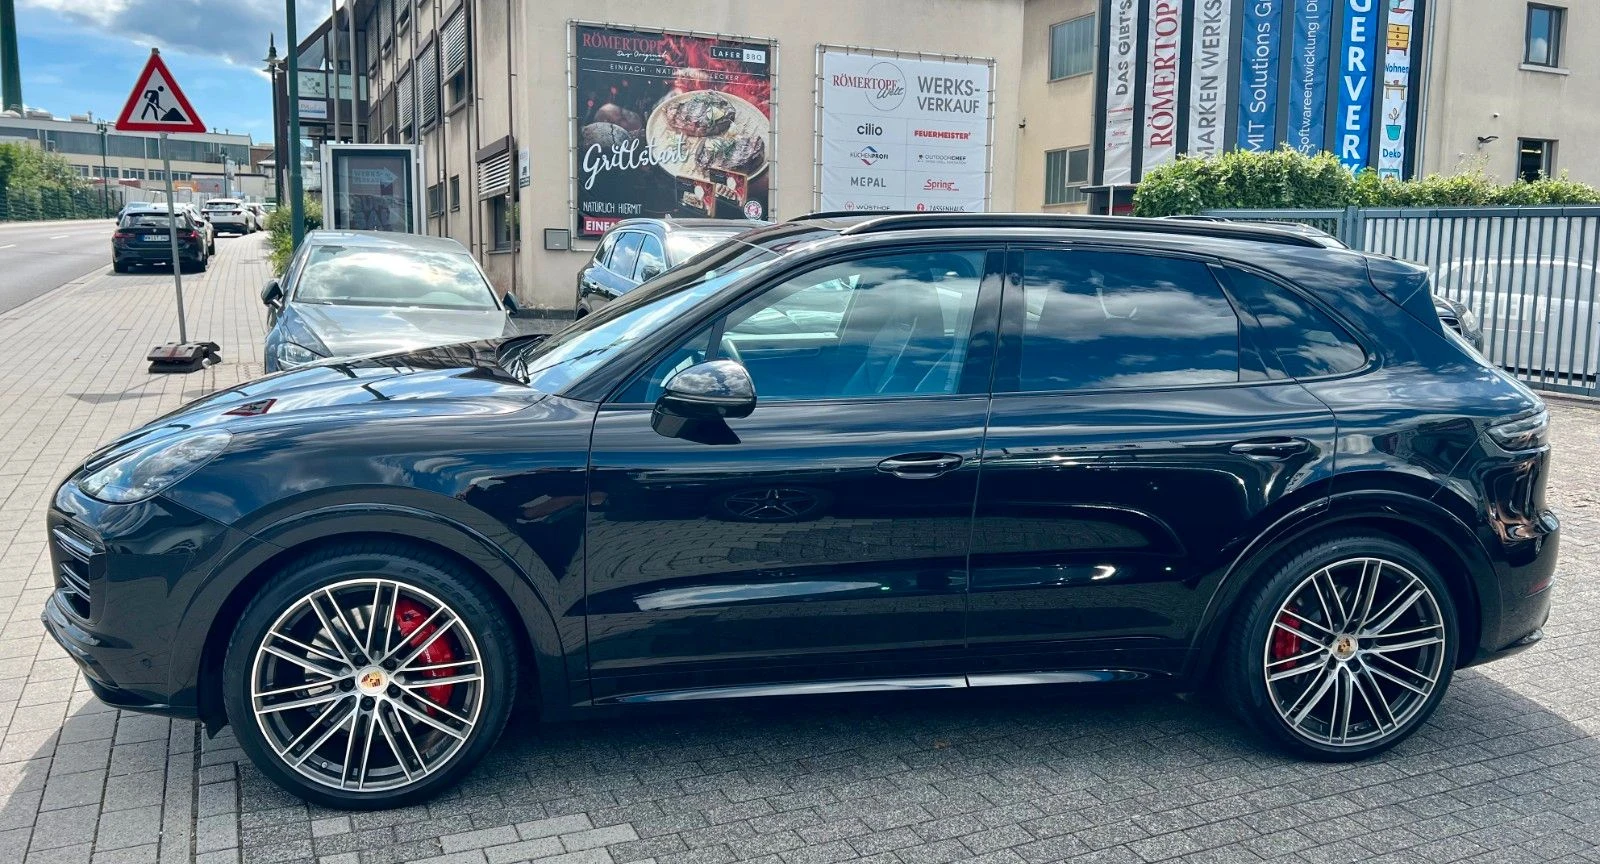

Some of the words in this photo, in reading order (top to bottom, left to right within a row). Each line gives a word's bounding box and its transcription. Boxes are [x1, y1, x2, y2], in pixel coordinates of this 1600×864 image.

[583, 32, 665, 54] RÖMERTOPF
[712, 48, 741, 59] LAFER
[745, 53, 762, 61] BBQ
[610, 64, 646, 73] EINFACH
[1147, 0, 1178, 148] RÖMERTOP
[1249, 22, 1271, 113] Solutions
[832, 73, 897, 91] RÖMERTOPF
[917, 76, 980, 97] WERKS-
[1116, 62, 1129, 96] DAS
[877, 87, 904, 99] Welt
[1298, 23, 1320, 154] Softwareentwicklung
[917, 96, 980, 114] VERKAUF
[857, 123, 883, 137] cilio
[1382, 148, 1402, 159] Deko
[583, 136, 688, 190] Grillstart
[850, 176, 886, 188] MEPAL
[926, 178, 956, 192] Spring
